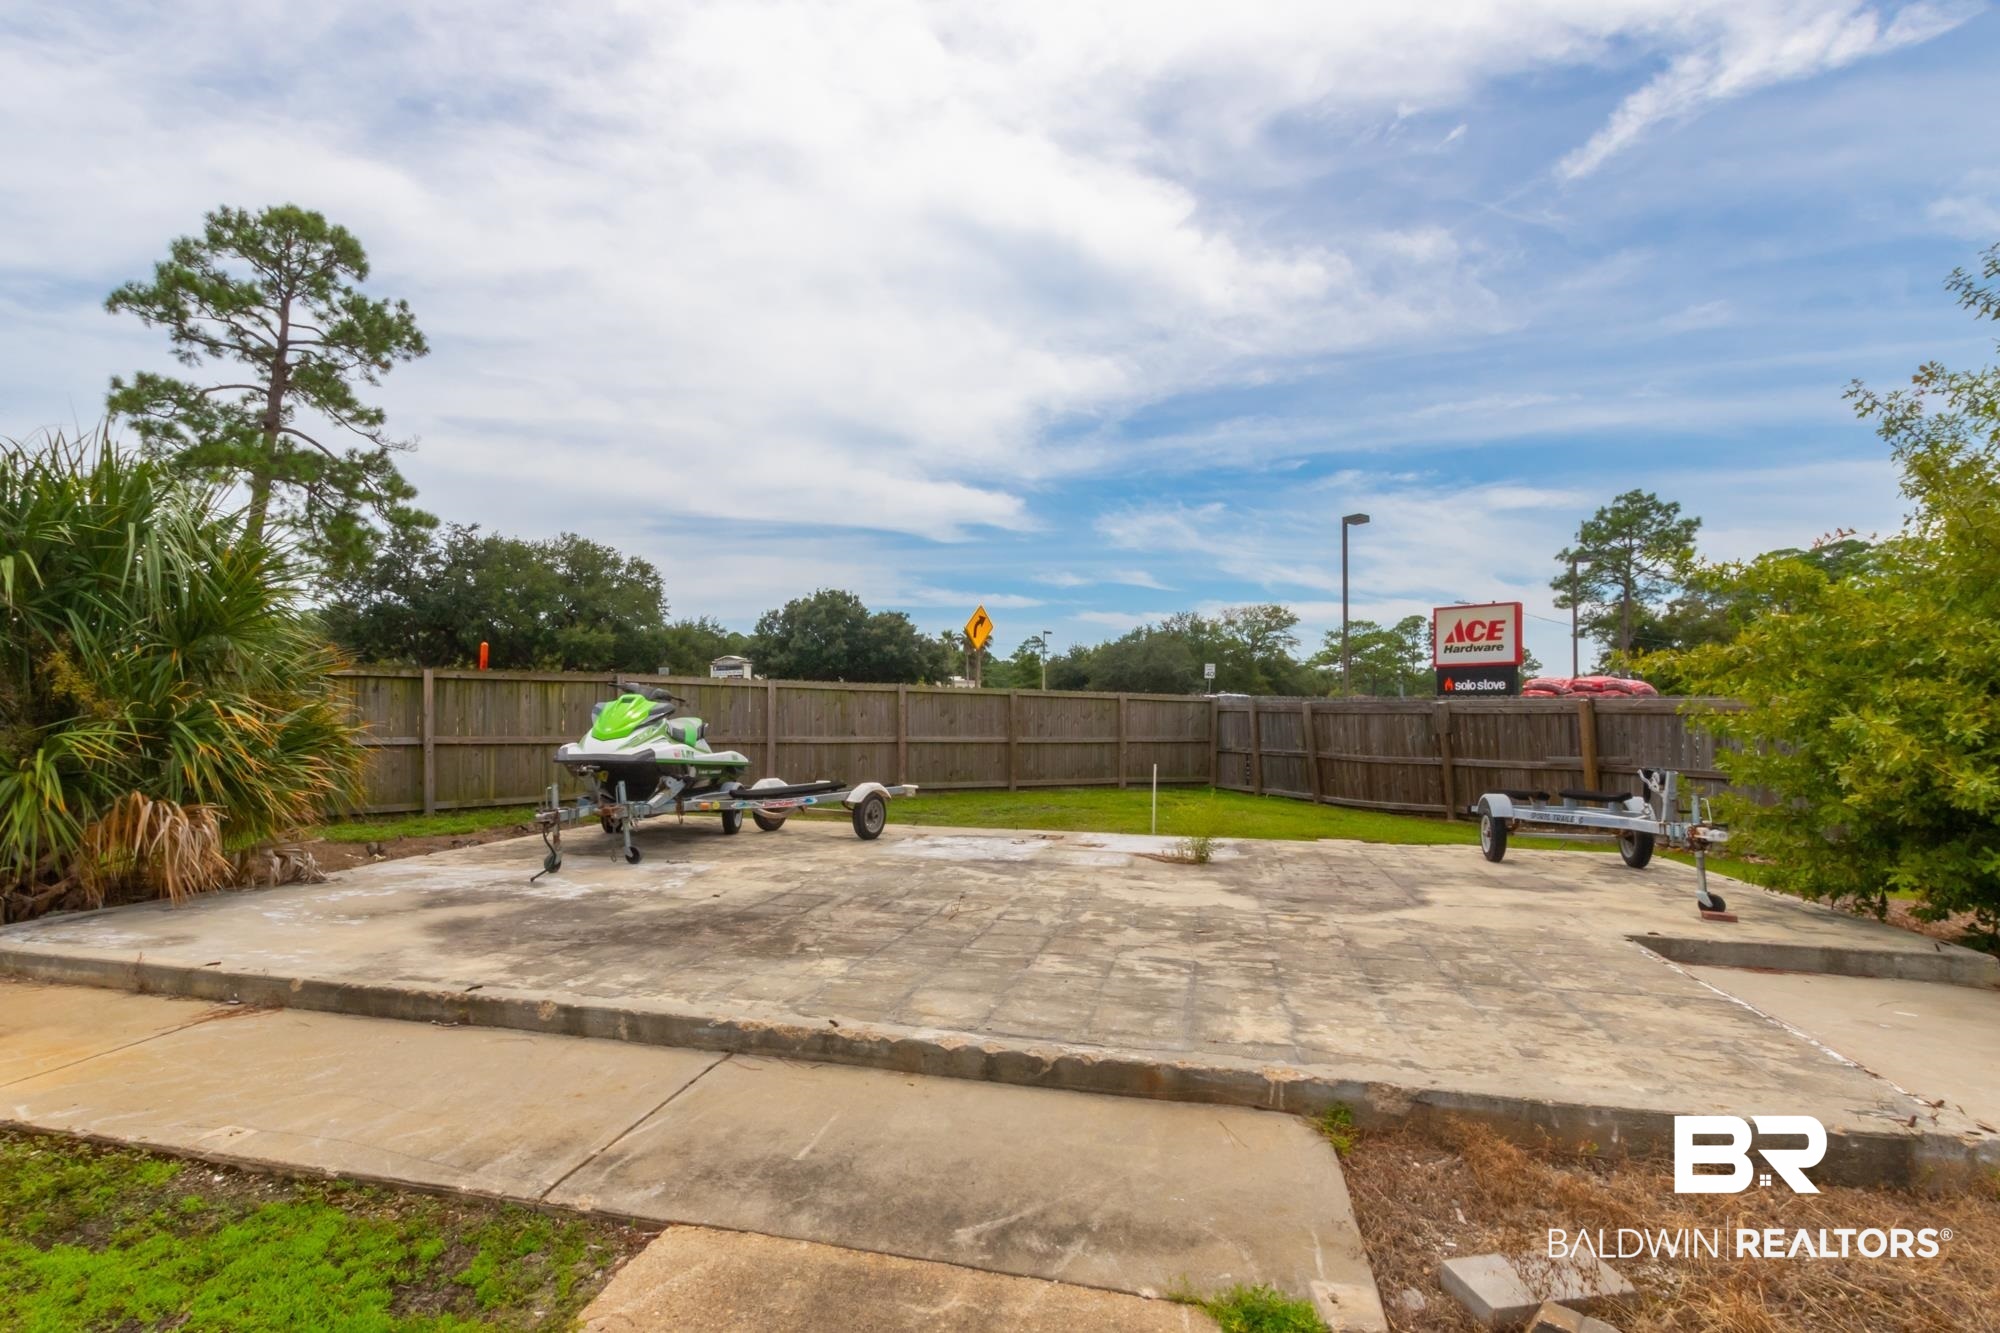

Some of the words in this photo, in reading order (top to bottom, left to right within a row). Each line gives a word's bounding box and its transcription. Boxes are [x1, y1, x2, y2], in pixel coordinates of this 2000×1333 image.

[1444, 619, 1506, 643] ACE
[1444, 644, 1504, 654] Hardware
[1455, 680, 1476, 690] solo
